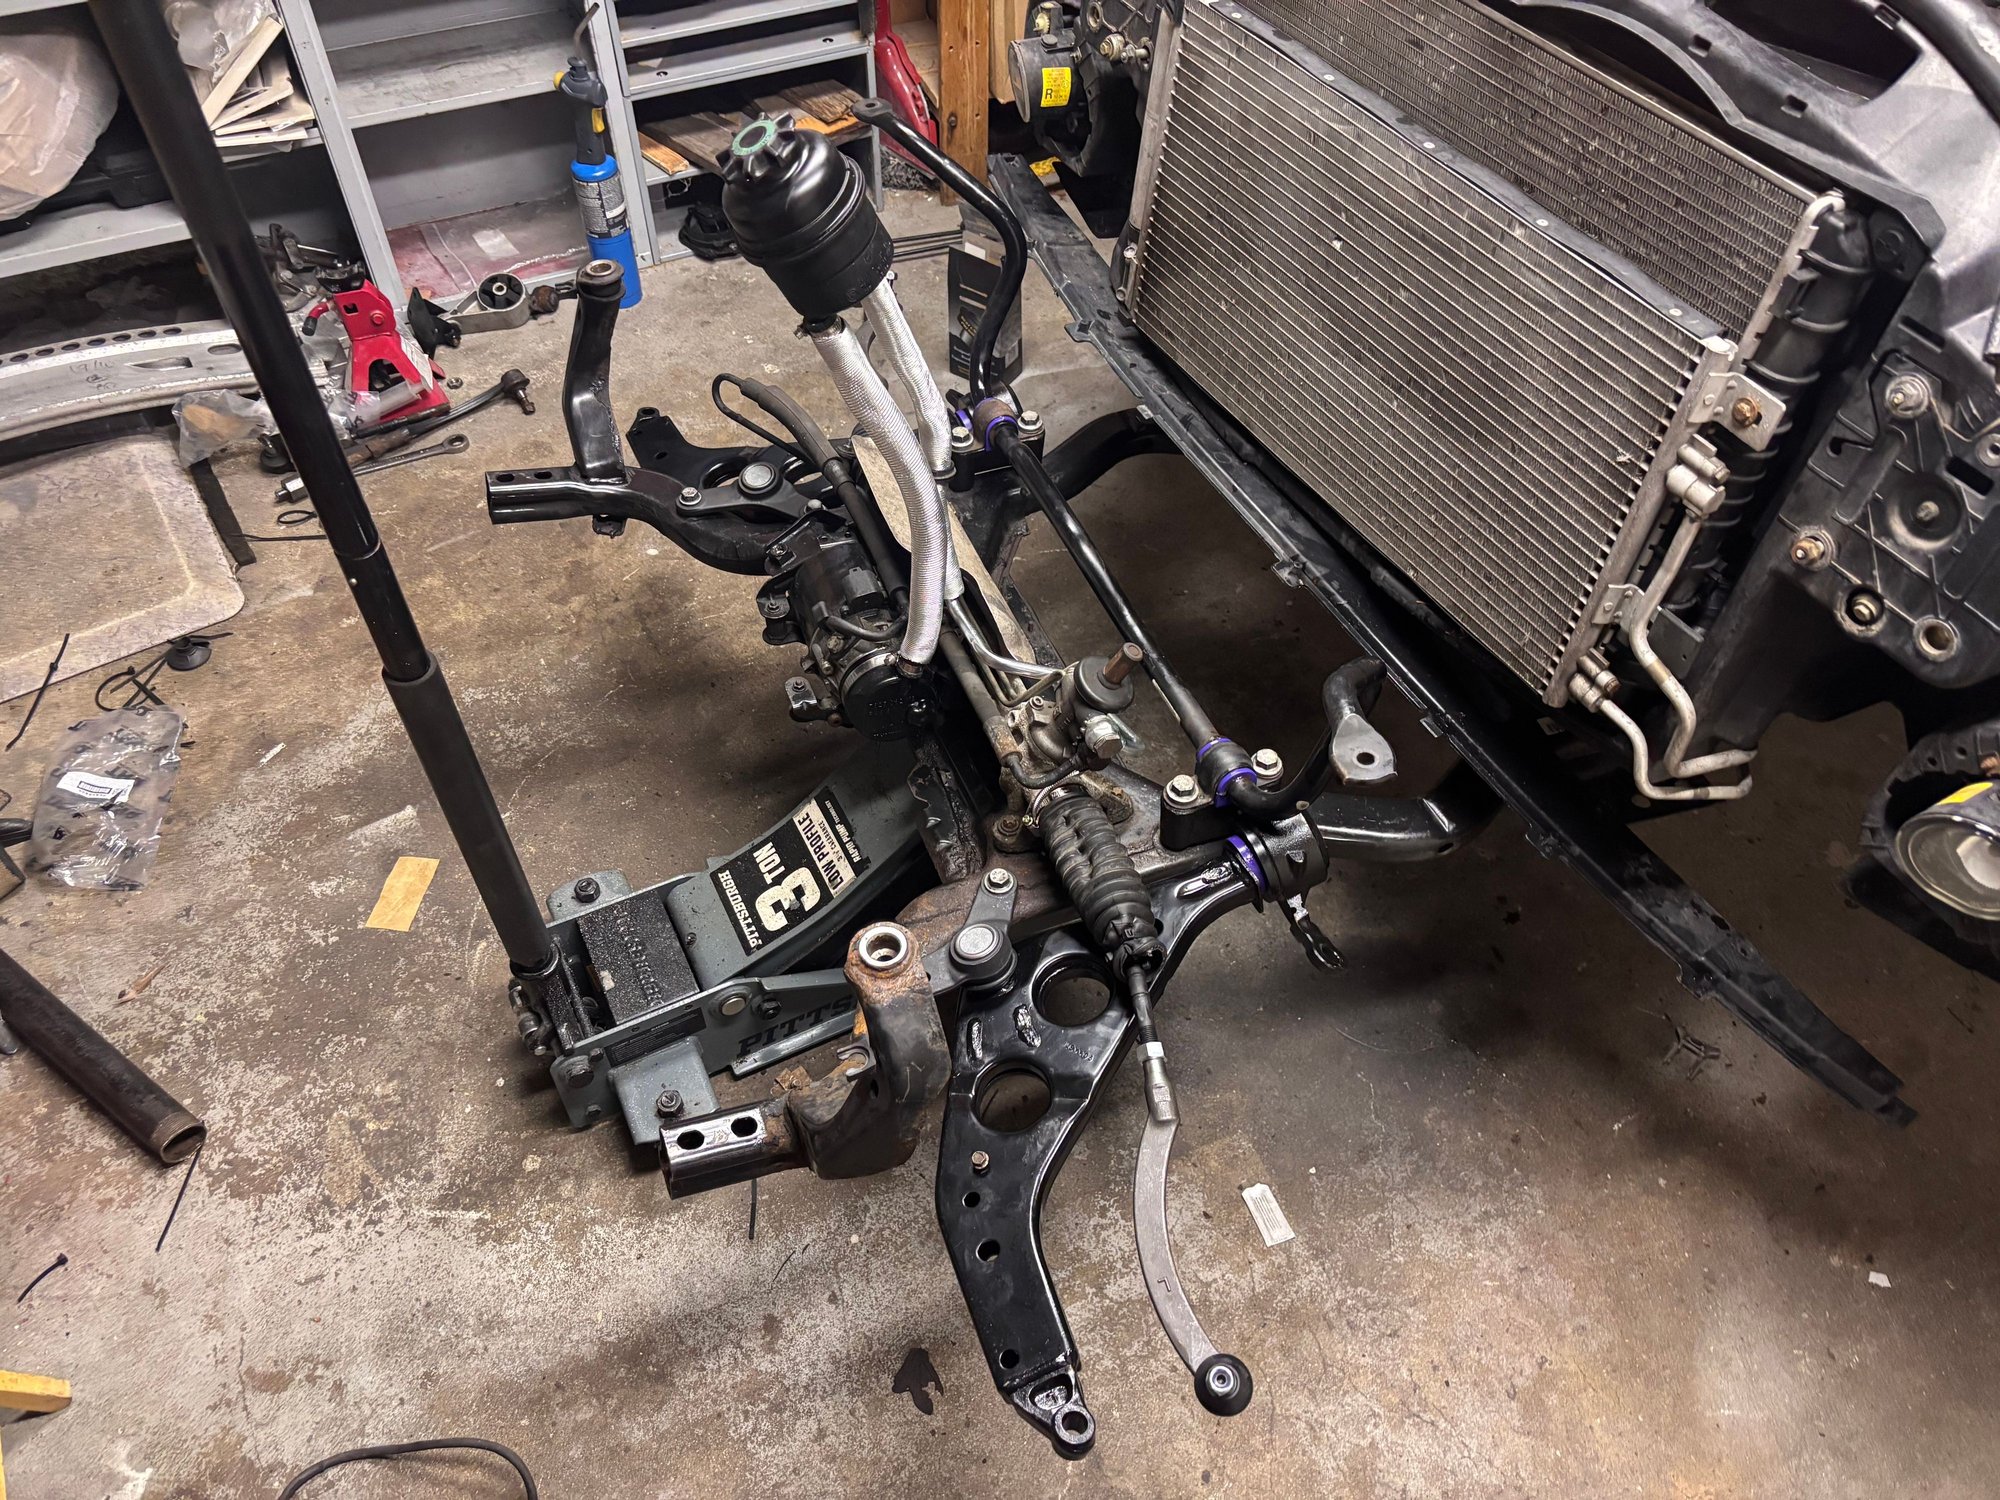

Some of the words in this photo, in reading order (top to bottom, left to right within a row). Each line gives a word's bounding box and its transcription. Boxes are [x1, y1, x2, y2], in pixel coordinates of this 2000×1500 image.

[798, 813, 830, 862] PROFILE
[818, 820, 837, 850] CLEARANCE
[836, 823, 851, 843] PUMP
[753, 842, 785, 884] TON
[845, 841, 862, 863] RAPID
[822, 860, 844, 890] LOW
[718, 870, 762, 949] PITTSBURGH
[755, 867, 821, 931] 3
